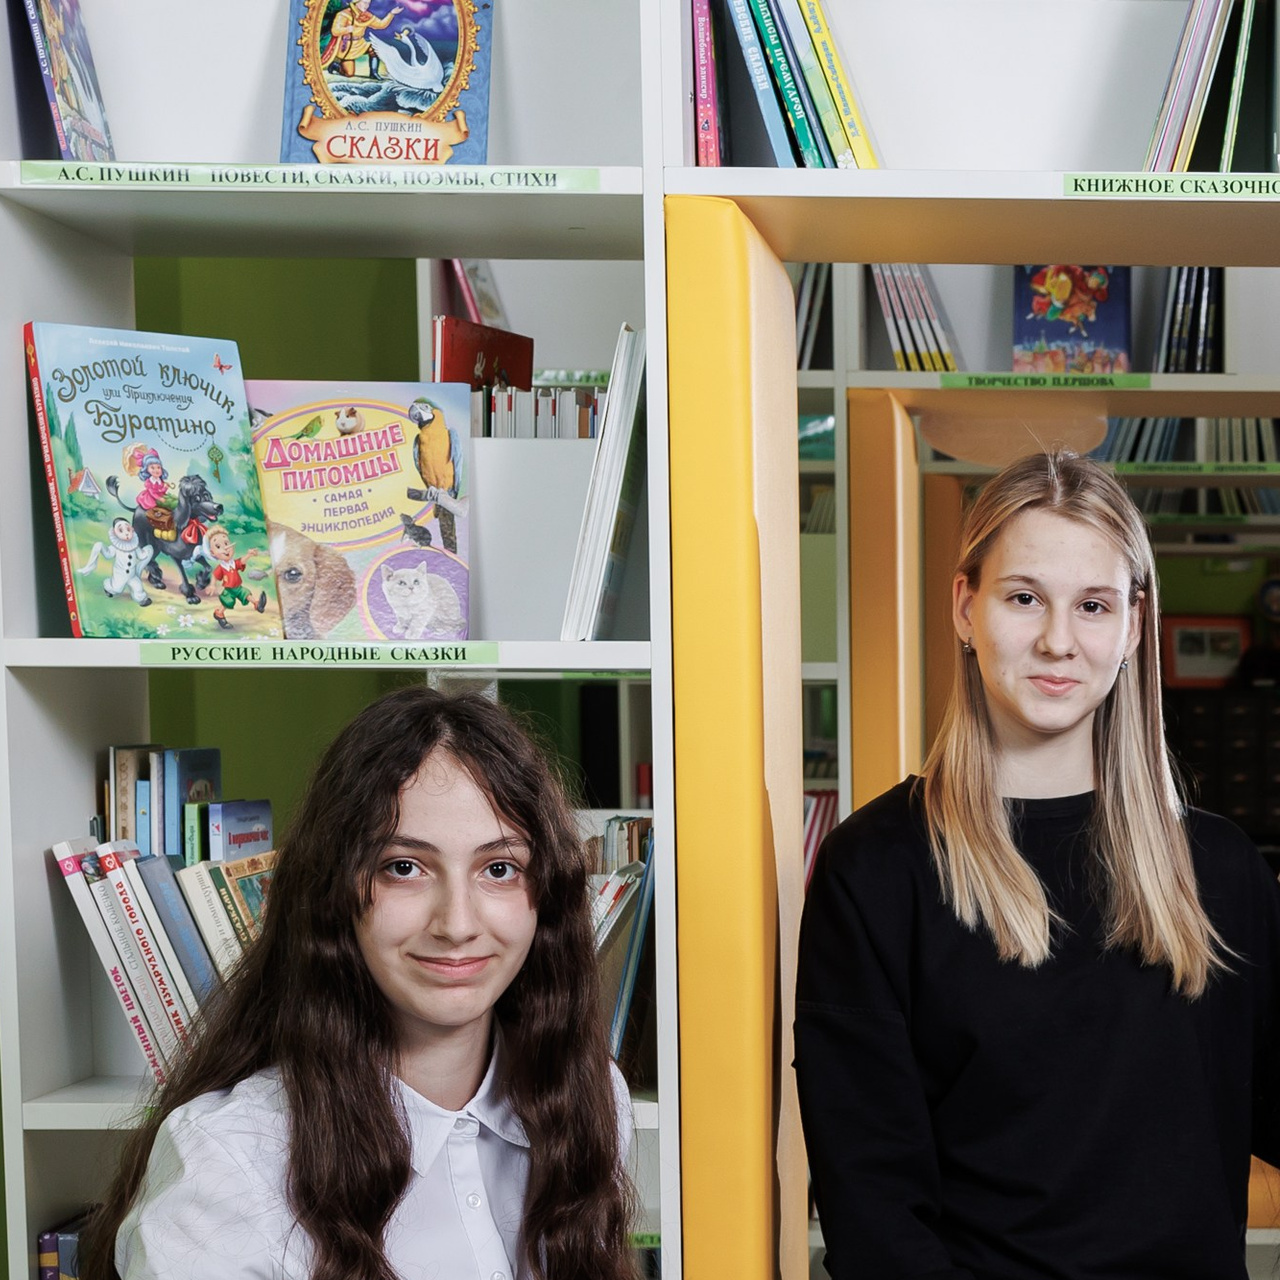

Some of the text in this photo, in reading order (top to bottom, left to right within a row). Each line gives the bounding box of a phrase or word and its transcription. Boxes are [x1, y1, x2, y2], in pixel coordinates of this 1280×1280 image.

[31, 23, 45, 60] ПУШКИН
[697, 16, 708, 99] Волшебный эликсир
[747, 46, 770, 91] СКАЗКИ
[773, 48, 805, 120] ПРЕМУДРОЙ
[375, 122, 422, 132] ПУШКИН
[326, 134, 440, 161] СКАЗКИ
[99, 167, 190, 182] ПУШКИН
[210, 168, 309, 186] ПОВЕСТИ,
[314, 169, 397, 187] СКАЗКИ,
[403, 171, 485, 188] ПОЭМЫ,
[490, 171, 557, 187] СТИХИ
[1073, 178, 1175, 193] КНИЖНОЕ
[52, 354, 235, 421] Золотой ключик,
[102, 384, 194, 411] или Приключения
[84, 399, 216, 443] Буратино
[282, 452, 400, 491] ПИТОМЦЫ
[323, 501, 369, 518] ПЕРВАЯ
[324, 488, 363, 504] САМАЯ
[301, 506, 396, 533] ЭНЦИКЛОПЕДИЯ
[171, 646, 467, 662] РУССКИЕ НАРОДНЫЕ СКАЗКИ
[96, 884, 121, 927] КОЛЕЧКО
[115, 881, 141, 926] ГОРОДА
[114, 924, 139, 971] СТАЛЬНОЕ
[134, 927, 175, 1008] ИЗУМРУДНОГО
[109, 965, 136, 1012] ЦВЕТОК
